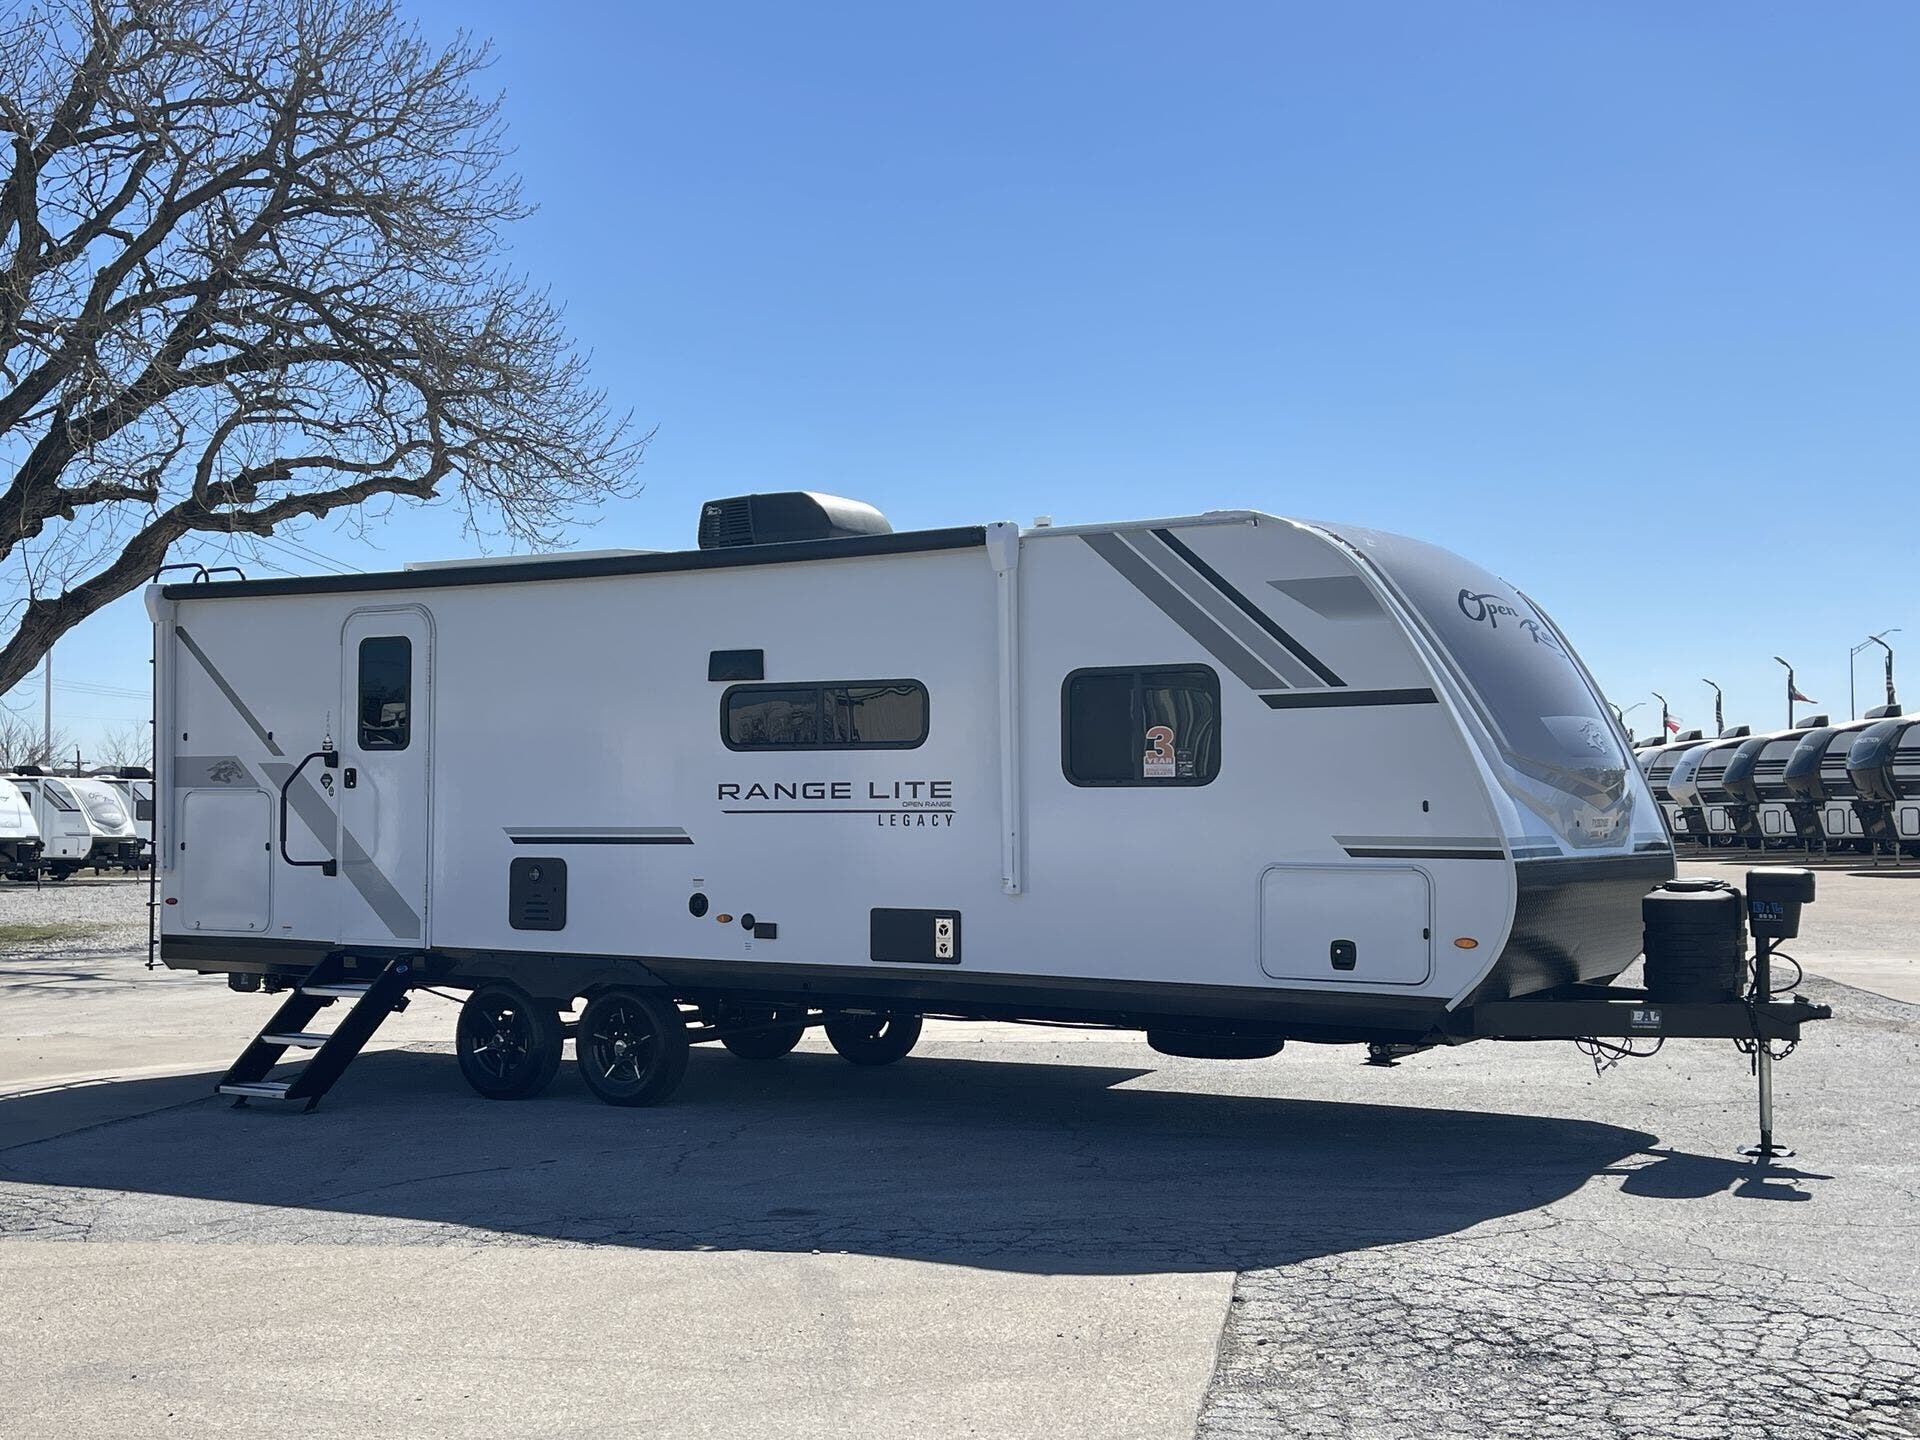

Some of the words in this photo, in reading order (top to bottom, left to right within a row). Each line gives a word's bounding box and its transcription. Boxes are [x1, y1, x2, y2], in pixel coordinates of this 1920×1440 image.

[1458, 588, 1519, 628] Open
[1146, 725, 1174, 759] 3
[717, 782, 851, 800] RANGE
[869, 781, 952, 799] LITE
[878, 814, 953, 826] LEGACY
